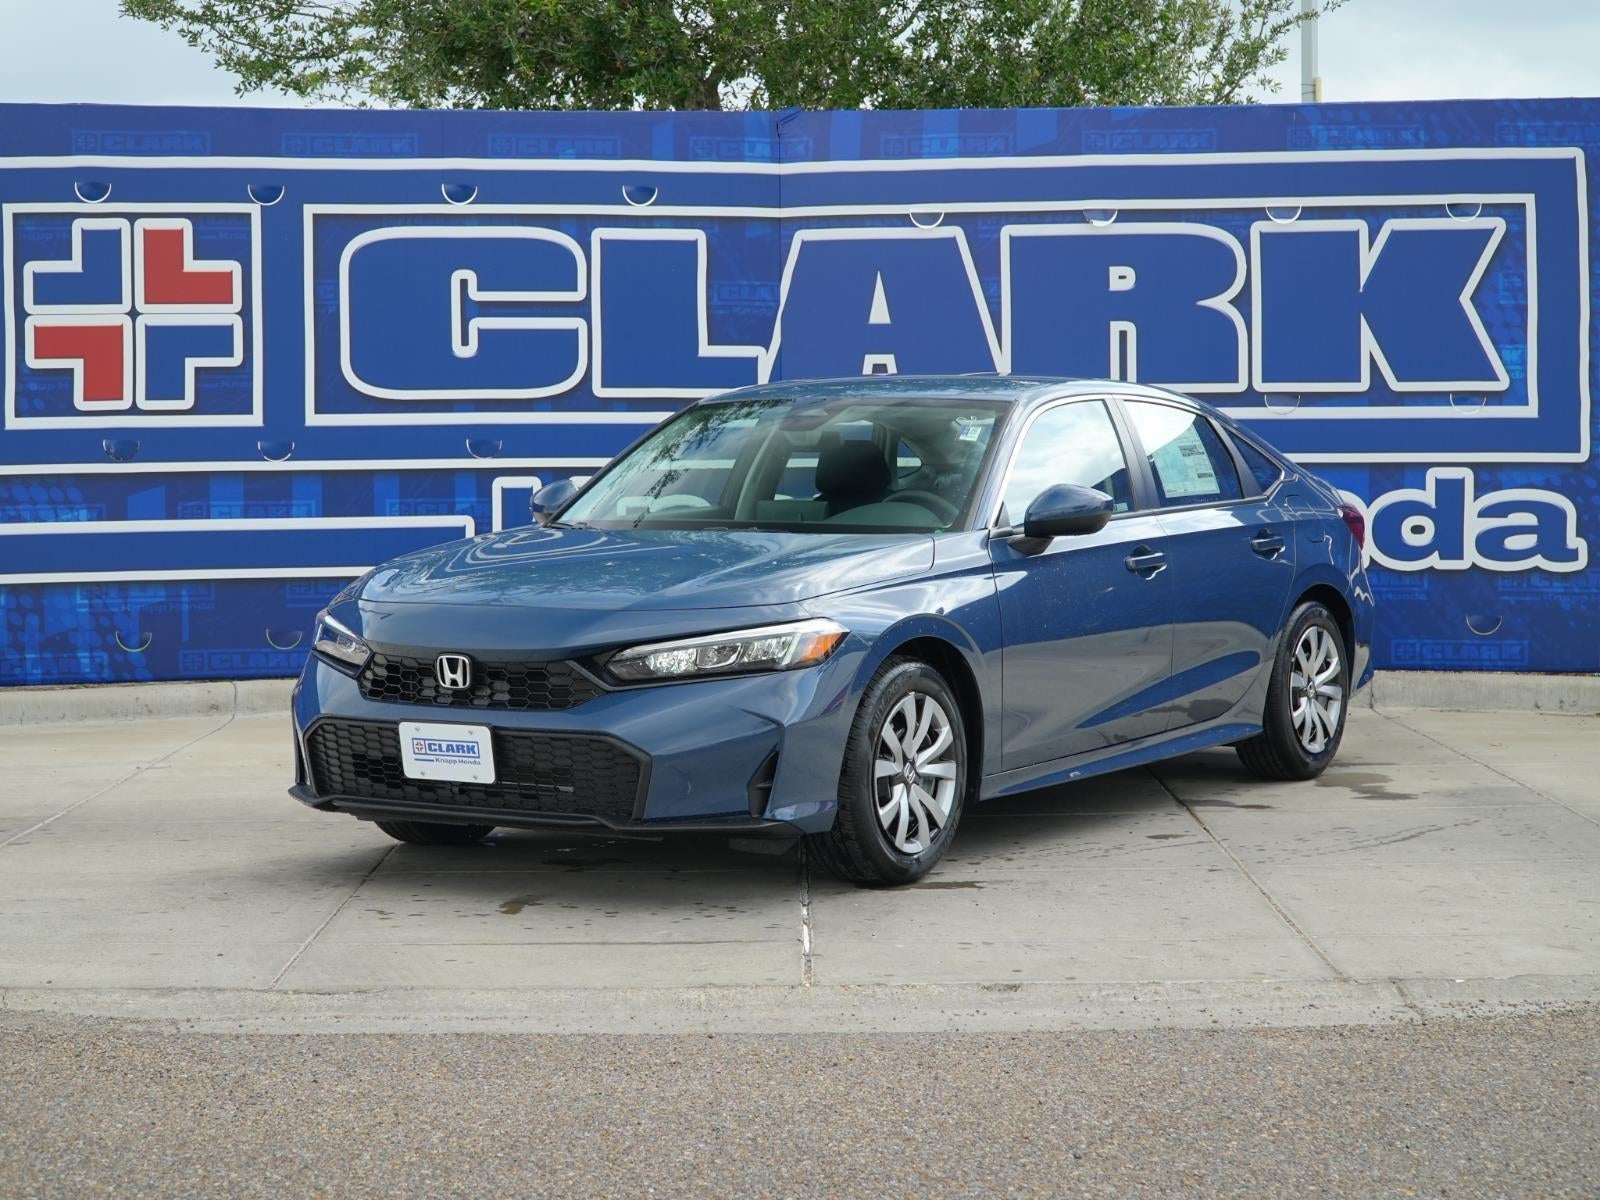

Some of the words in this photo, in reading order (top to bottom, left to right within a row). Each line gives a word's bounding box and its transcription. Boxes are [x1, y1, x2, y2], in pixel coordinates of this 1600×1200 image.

[339, 217, 1510, 400] CLARK
[427, 742, 477, 755] CLARK
[434, 757, 458, 765] Knapp
[458, 758, 481, 766] Honda
